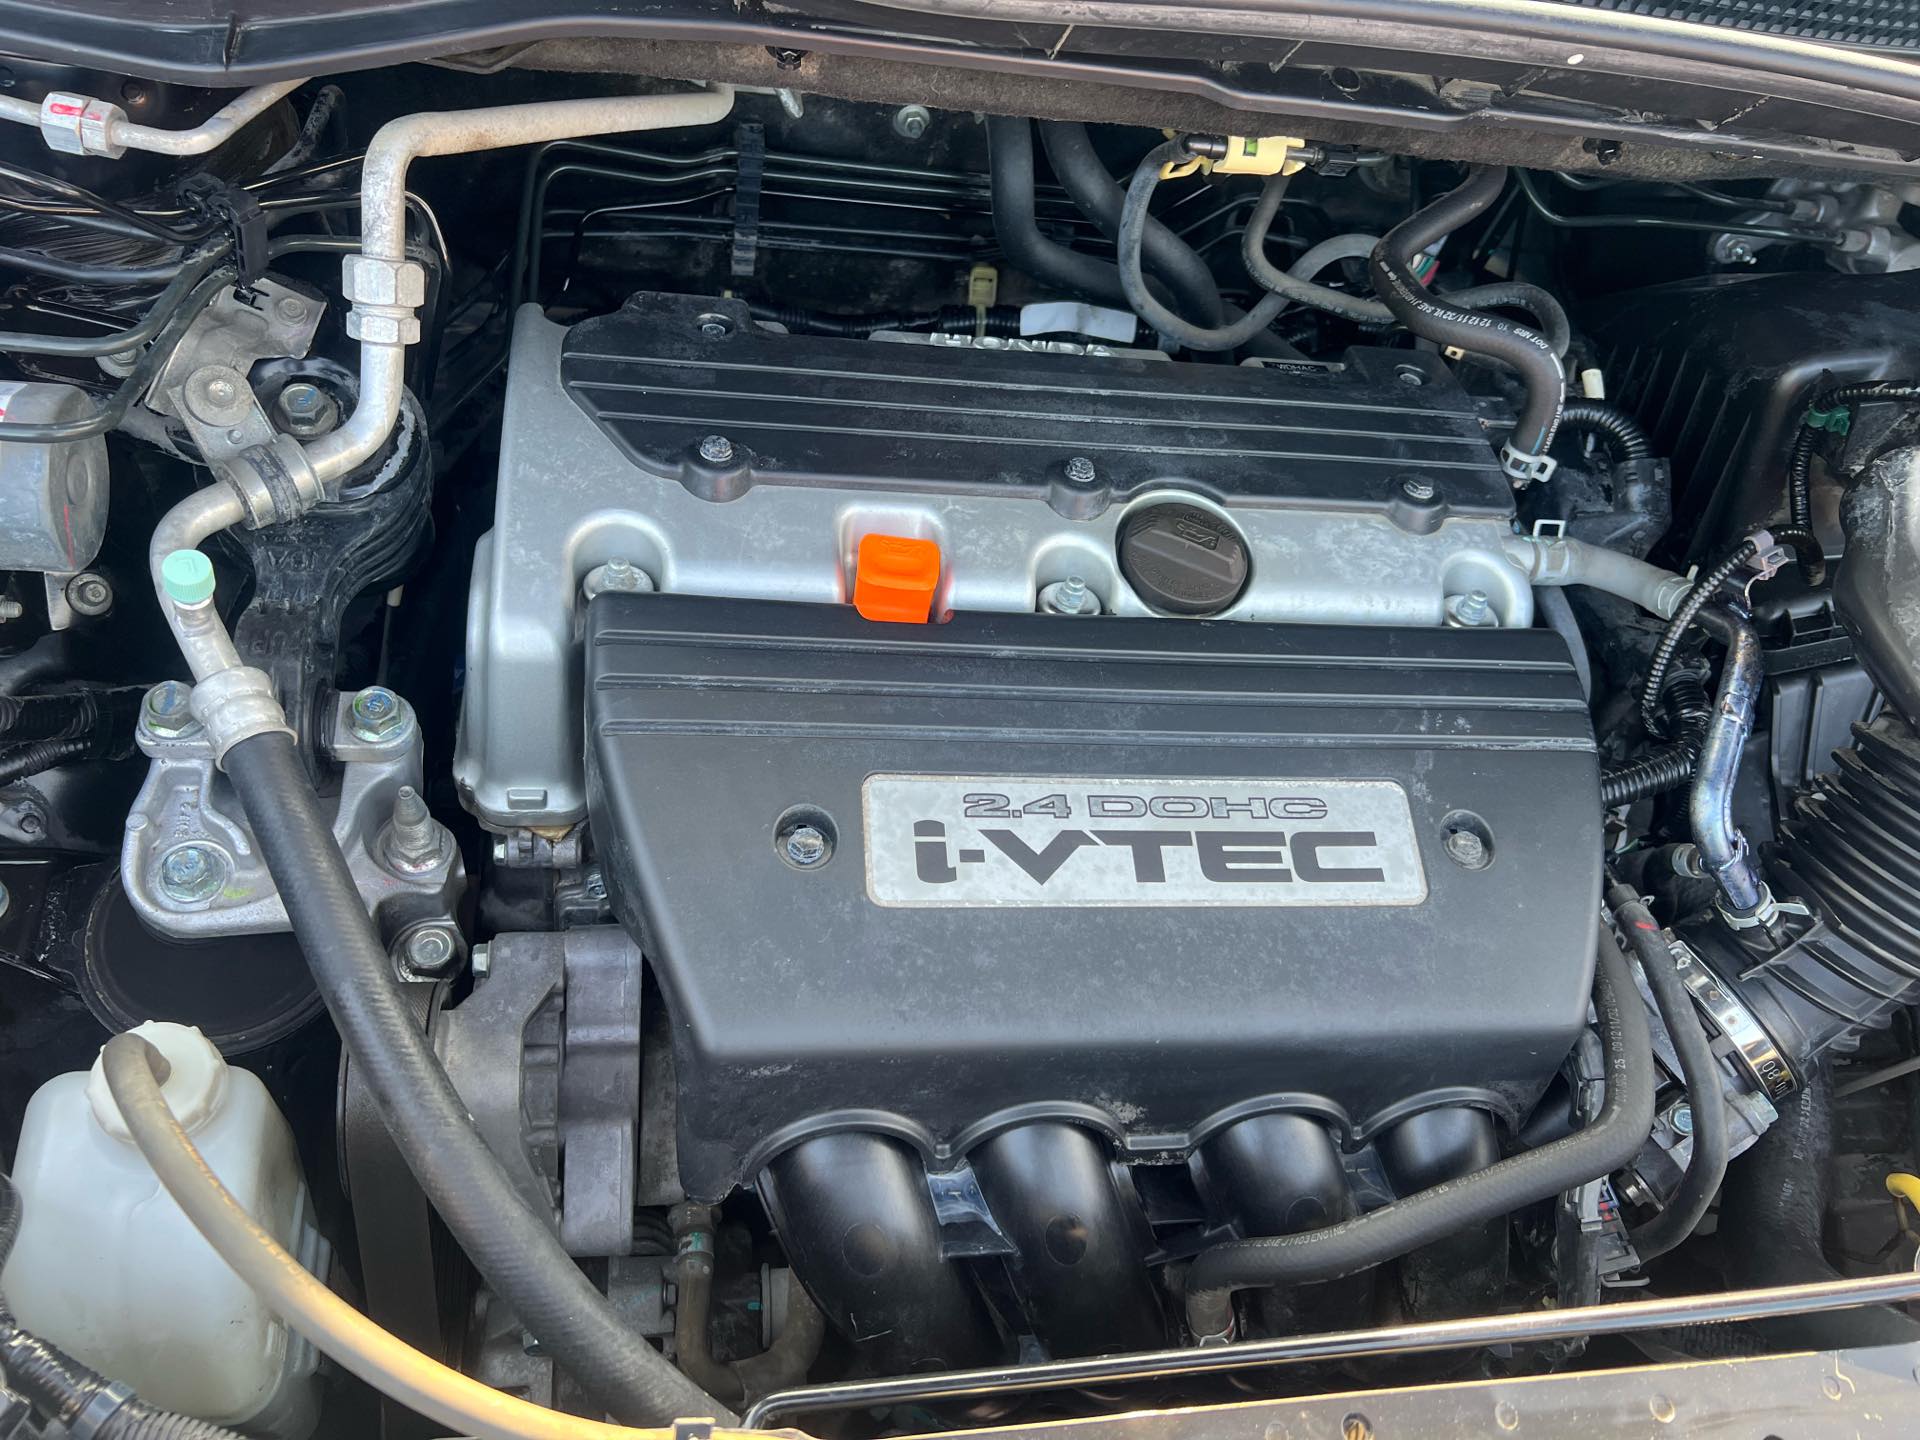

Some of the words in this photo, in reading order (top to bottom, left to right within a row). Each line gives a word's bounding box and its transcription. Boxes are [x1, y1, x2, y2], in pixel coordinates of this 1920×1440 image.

[963, 793, 1072, 819] 2.4
[1087, 795, 1328, 820] DOHC
[913, 819, 1385, 885] i-VTEC
